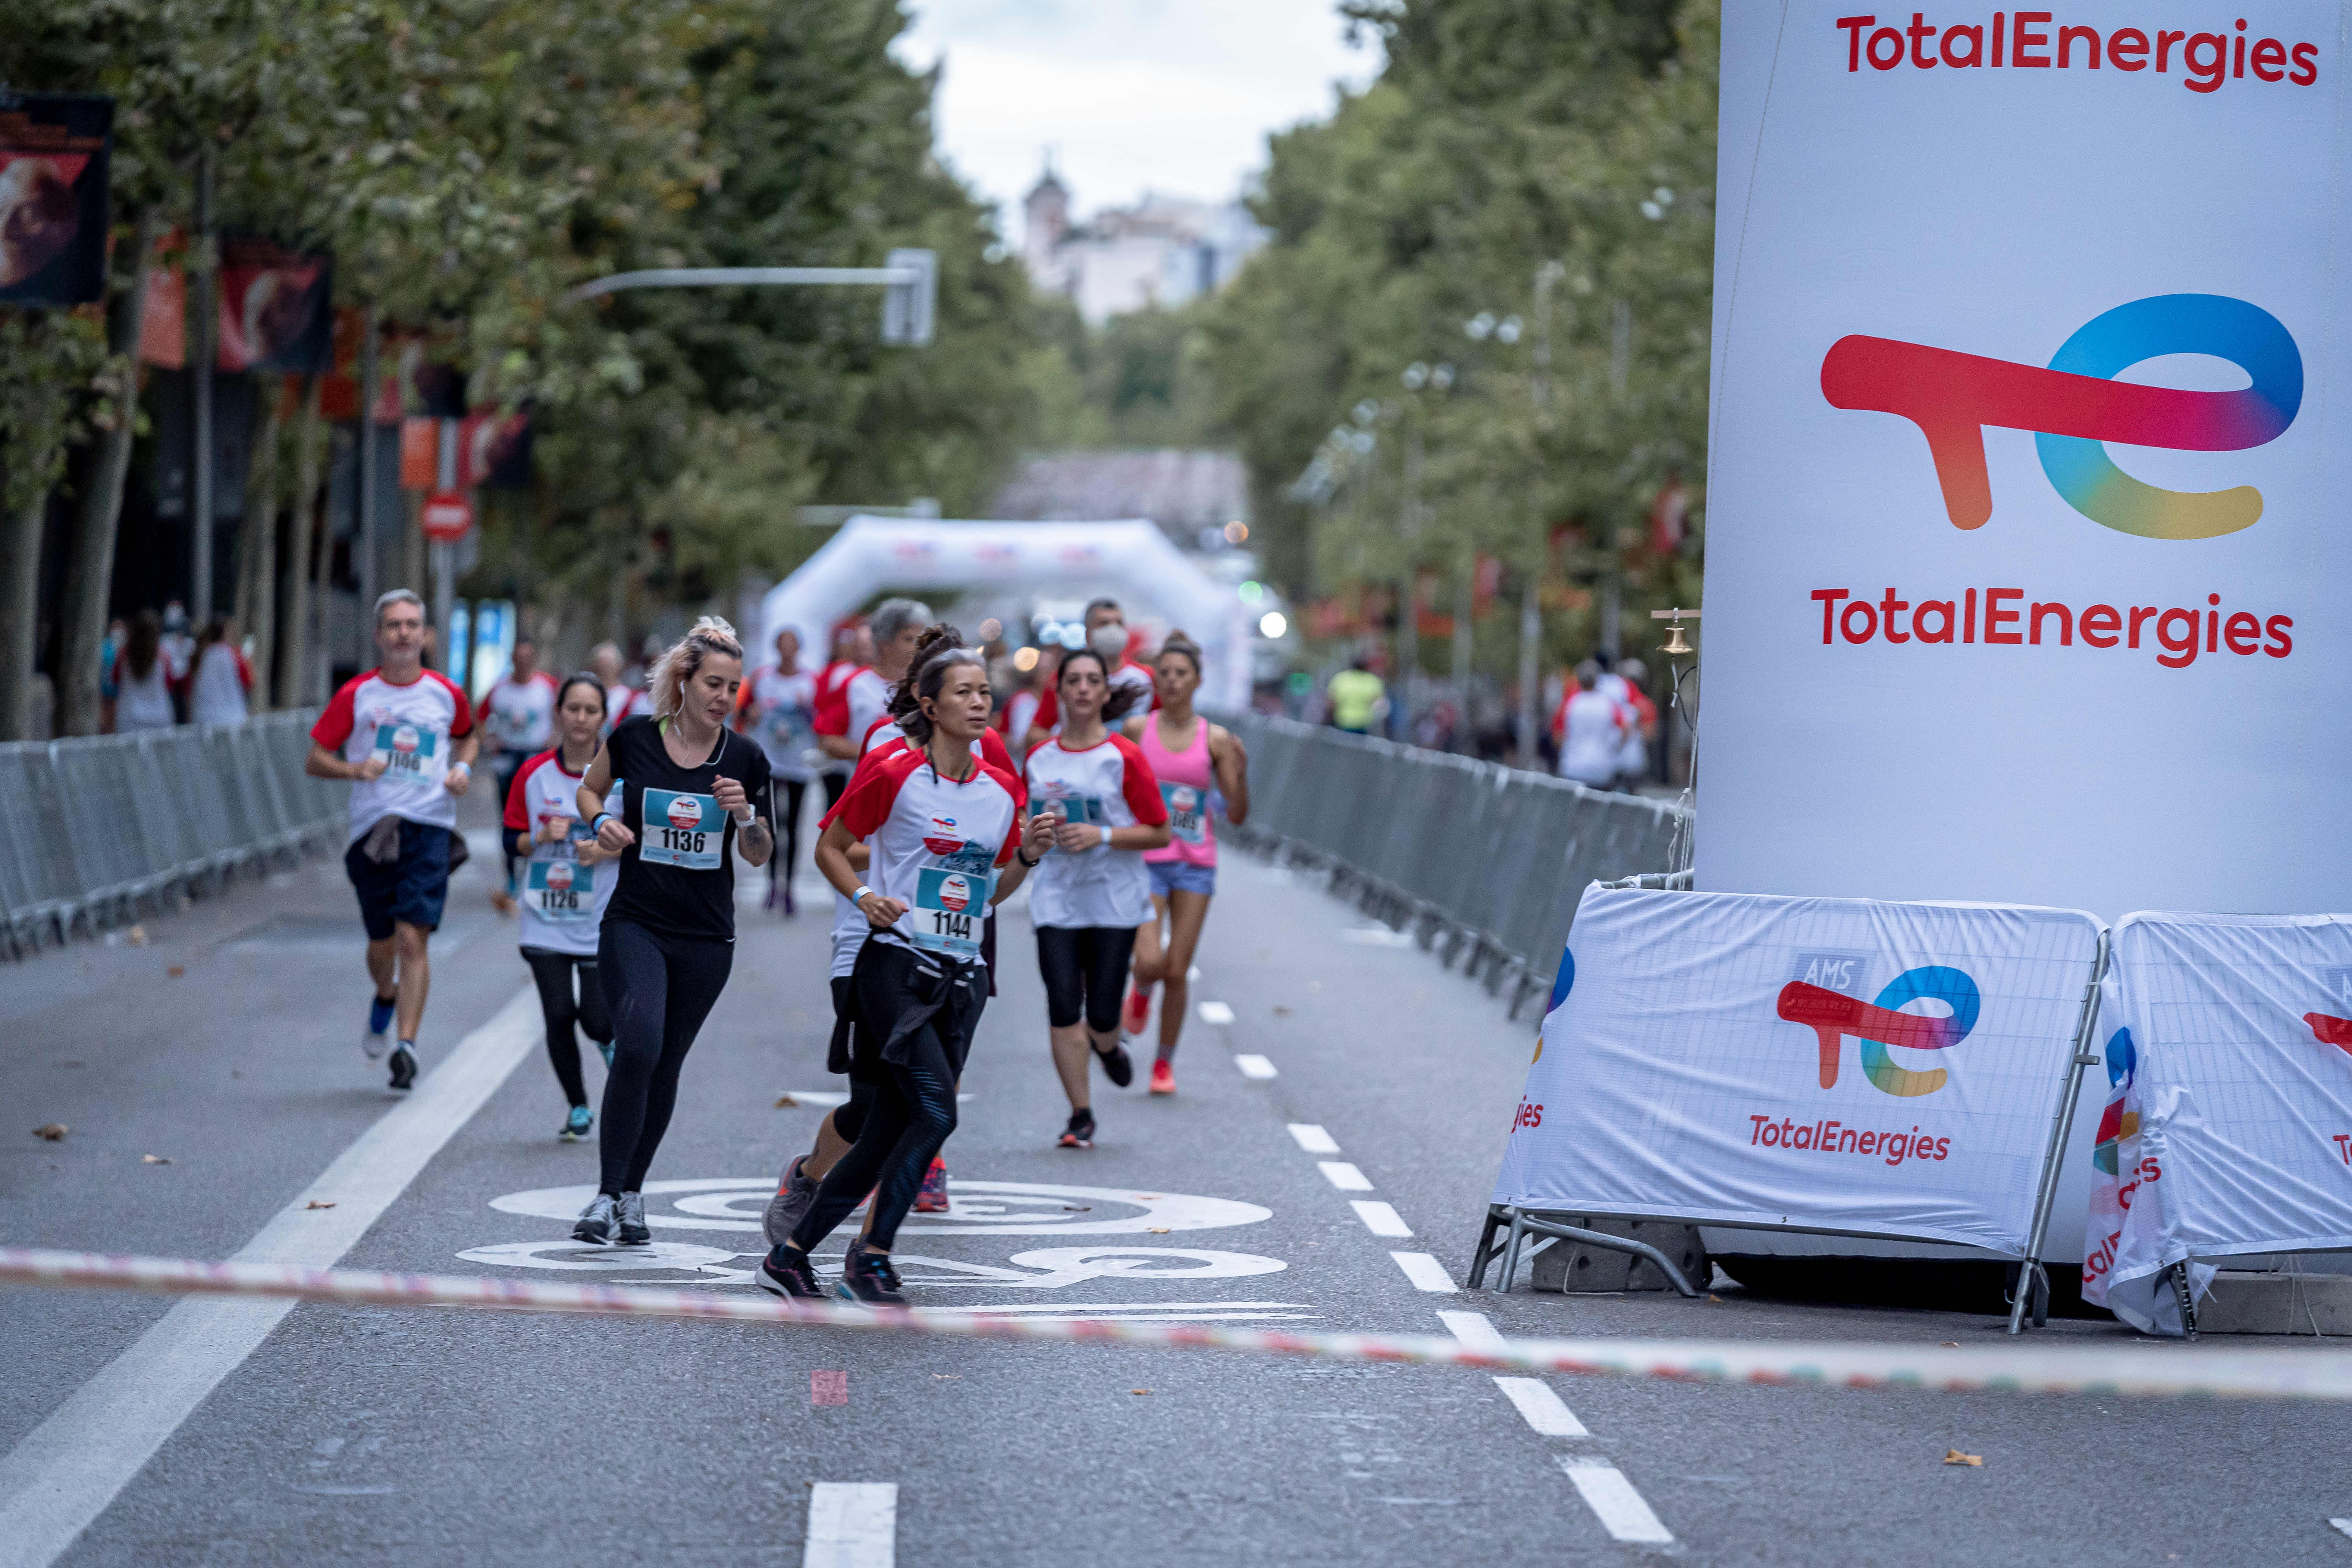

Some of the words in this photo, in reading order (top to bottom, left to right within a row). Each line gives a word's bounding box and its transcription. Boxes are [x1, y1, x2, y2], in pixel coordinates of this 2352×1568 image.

[1837, 11, 2318, 93] TotalEnergies
[1811, 587, 2294, 668] TotalEnergies
[661, 828, 706, 853] 1136
[541, 890, 579, 908] 1126
[932, 911, 971, 940] 1144
[1803, 958, 1855, 989] AMS
[1749, 1114, 1951, 1166] TotalEnergies
